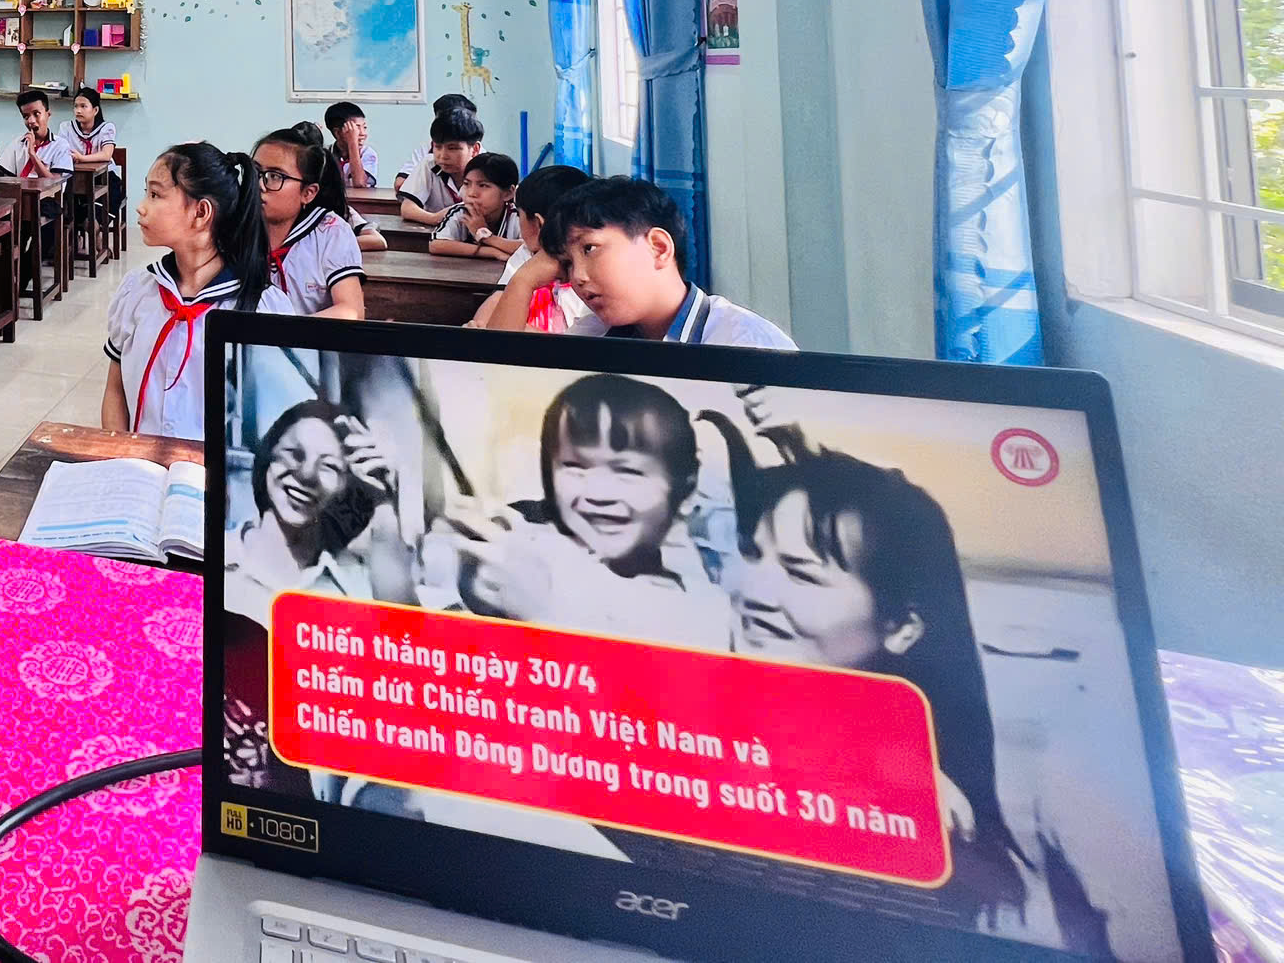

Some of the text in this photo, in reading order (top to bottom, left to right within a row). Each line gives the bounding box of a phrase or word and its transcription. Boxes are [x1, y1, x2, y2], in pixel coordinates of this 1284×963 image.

[296, 622, 597, 694] Chiến thắng ngày 30/4
[296, 664, 770, 767] chấm dứt Chiến tranh Việt Nam và
[297, 702, 917, 840] Chiến tranh Đông Dương trong suốt 30 năm
[226, 808, 242, 819] FULL
[226, 817, 306, 843] HD 1080
[615, 890, 690, 920] acer
